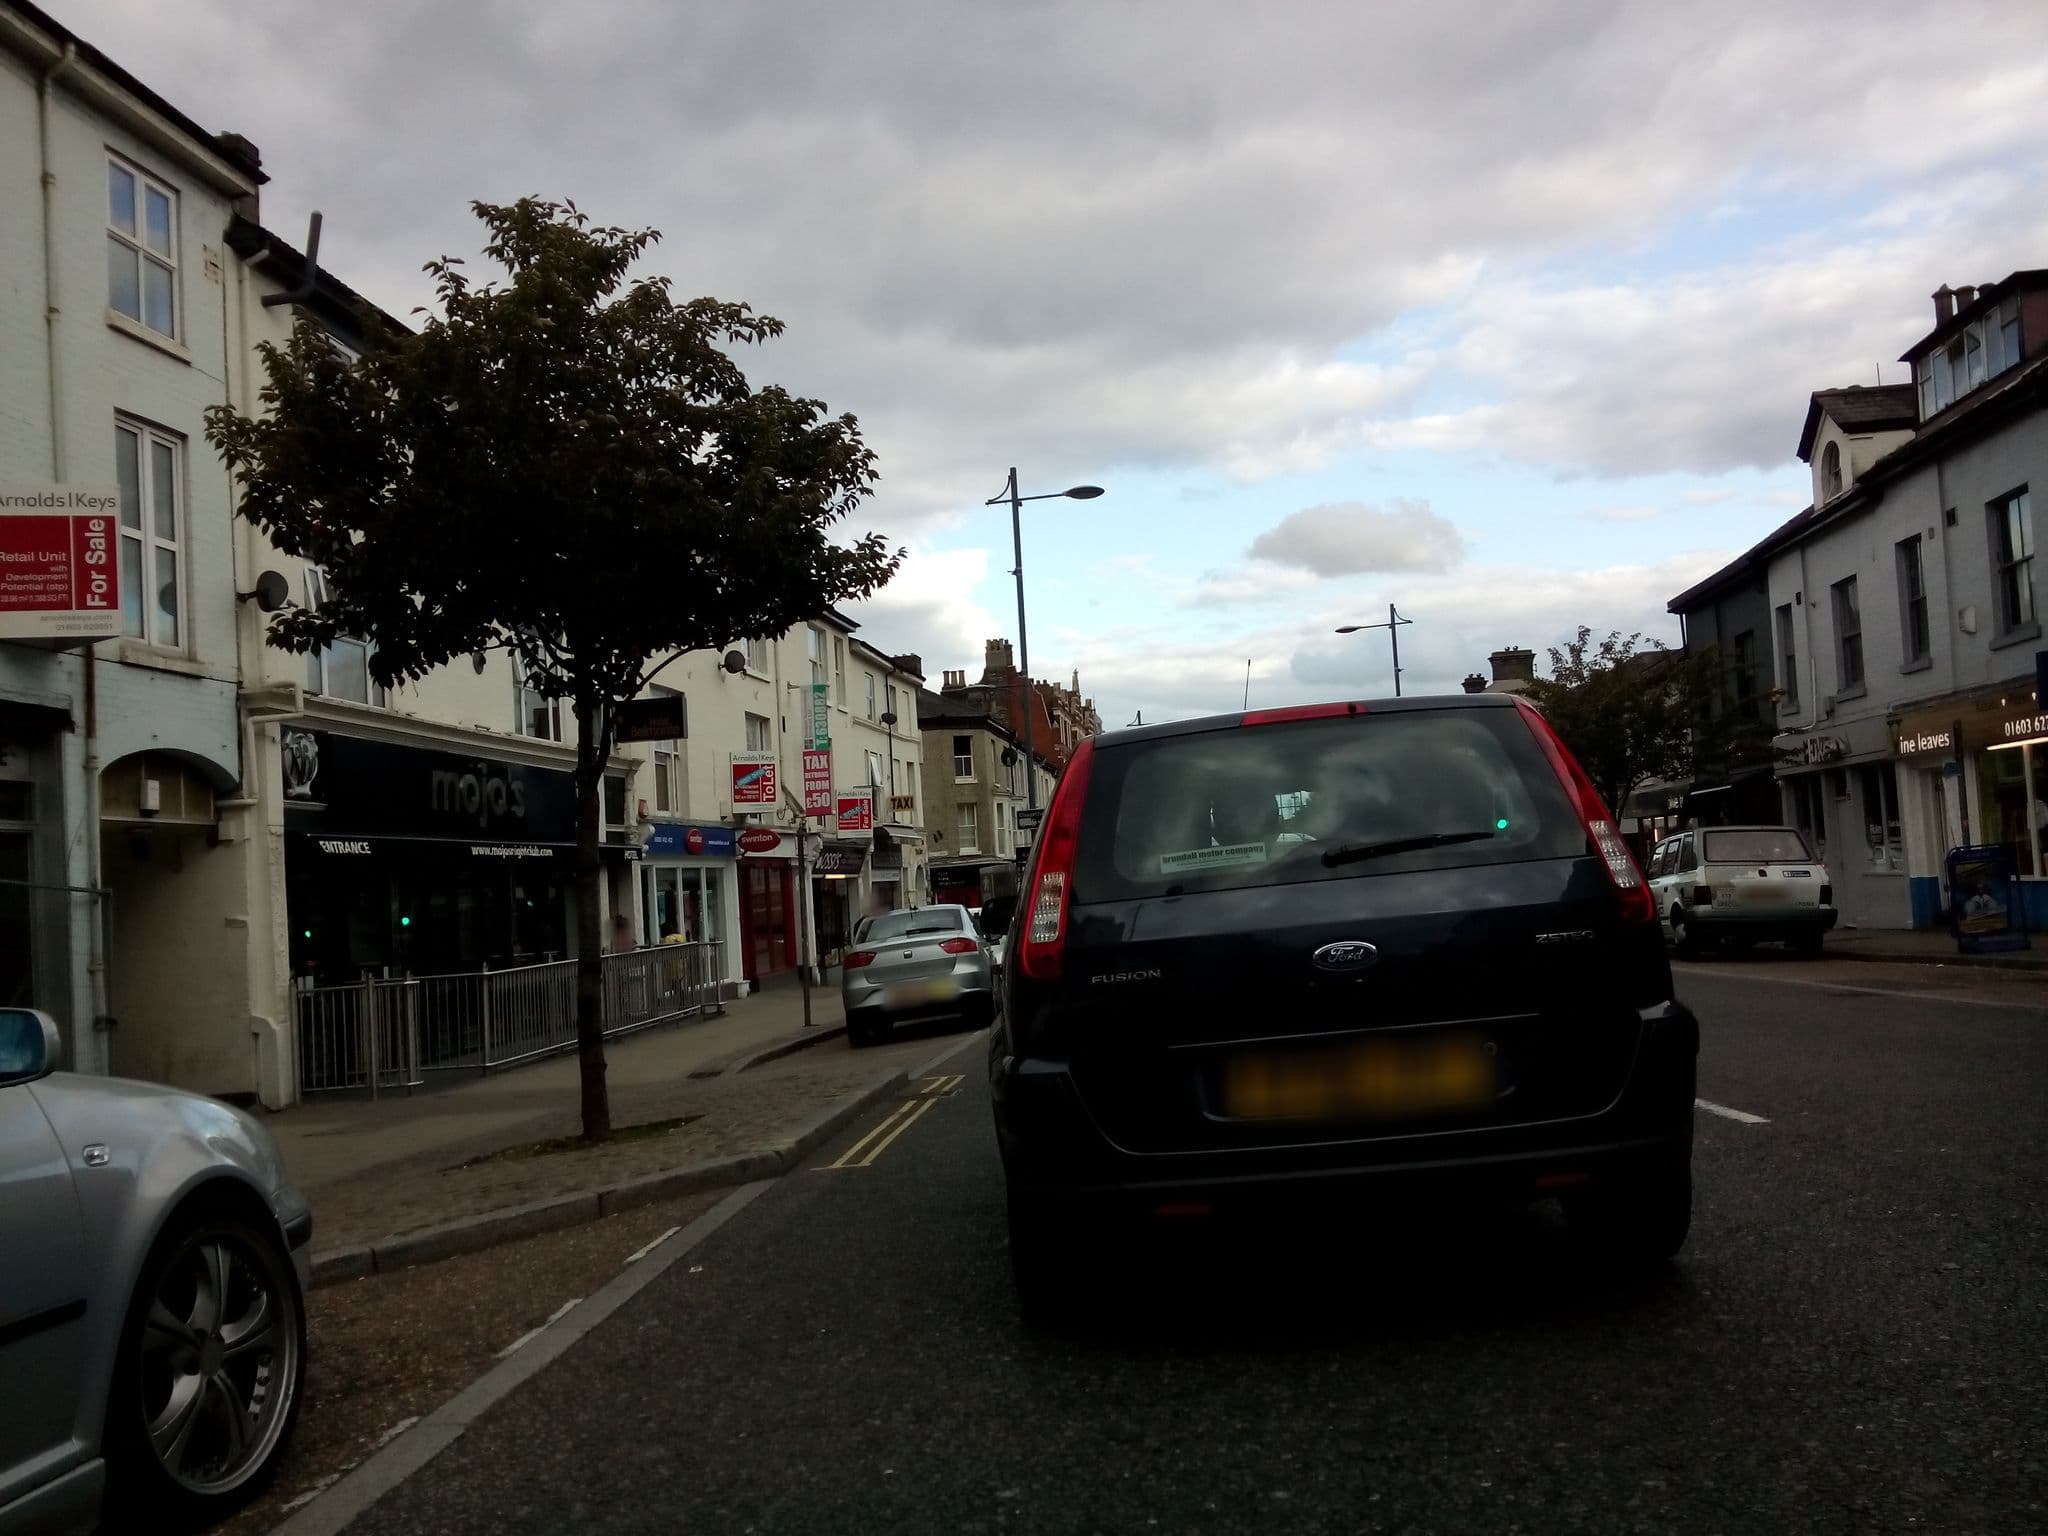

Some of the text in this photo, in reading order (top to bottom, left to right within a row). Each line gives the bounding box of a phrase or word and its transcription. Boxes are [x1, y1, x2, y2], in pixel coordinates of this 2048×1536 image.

[39, 552, 66, 562] Unit
[84, 519, 107, 606] For Sale
[6, 573, 67, 582] Development
[1, 582, 43, 591] Potential
[2004, 718, 2032, 737] 01603
[1917, 732, 1950, 751] leaves
[803, 755, 828, 770] TAX
[805, 780, 830, 791] FROM
[806, 792, 831, 809] £50
[890, 796, 914, 810] TAXI
[741, 834, 773, 844] swinton
[318, 840, 372, 854] ENTRANCE
[1199, 848, 1223, 859] motor
[1225, 845, 1264, 855] company
[1328, 946, 1366, 963] Ford
[1090, 968, 1163, 984] FUSION
